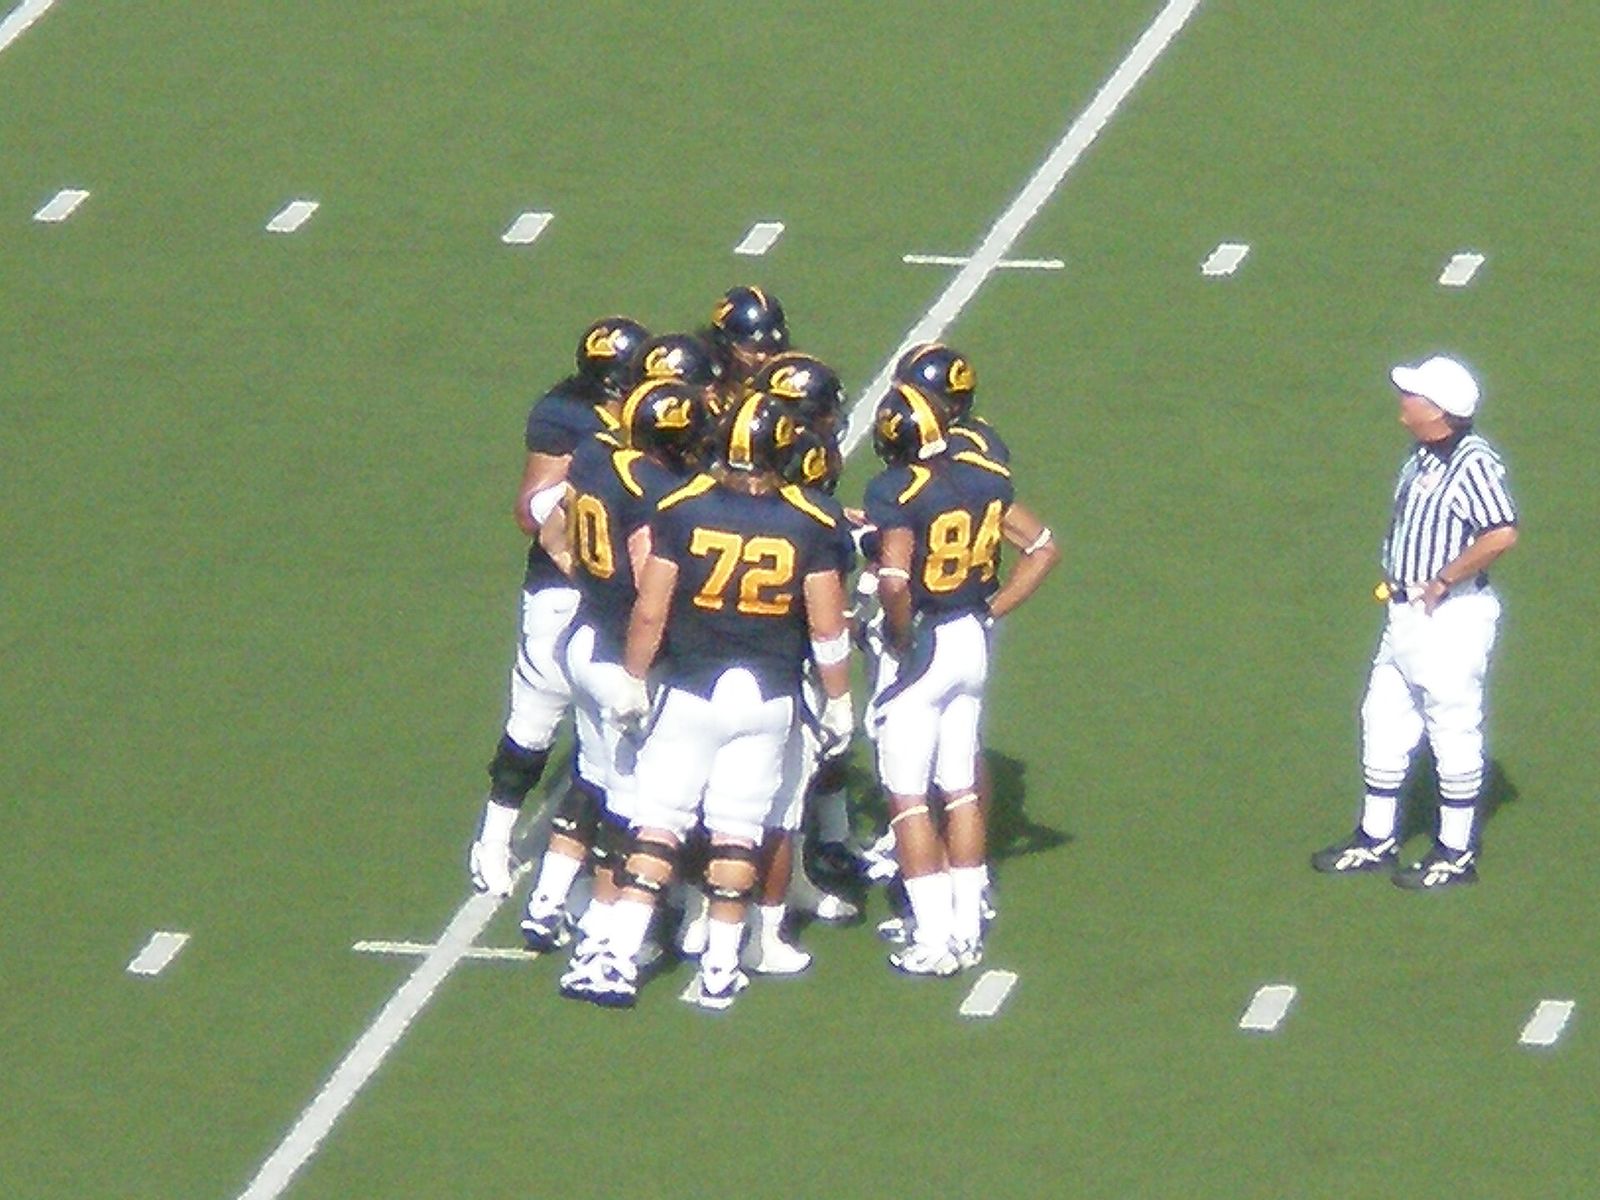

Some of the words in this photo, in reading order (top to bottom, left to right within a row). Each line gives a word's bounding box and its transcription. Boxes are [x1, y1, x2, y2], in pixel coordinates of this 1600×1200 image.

[569, 493, 615, 579] 0
[689, 526, 795, 616] 72
[924, 499, 1002, 592] 84
